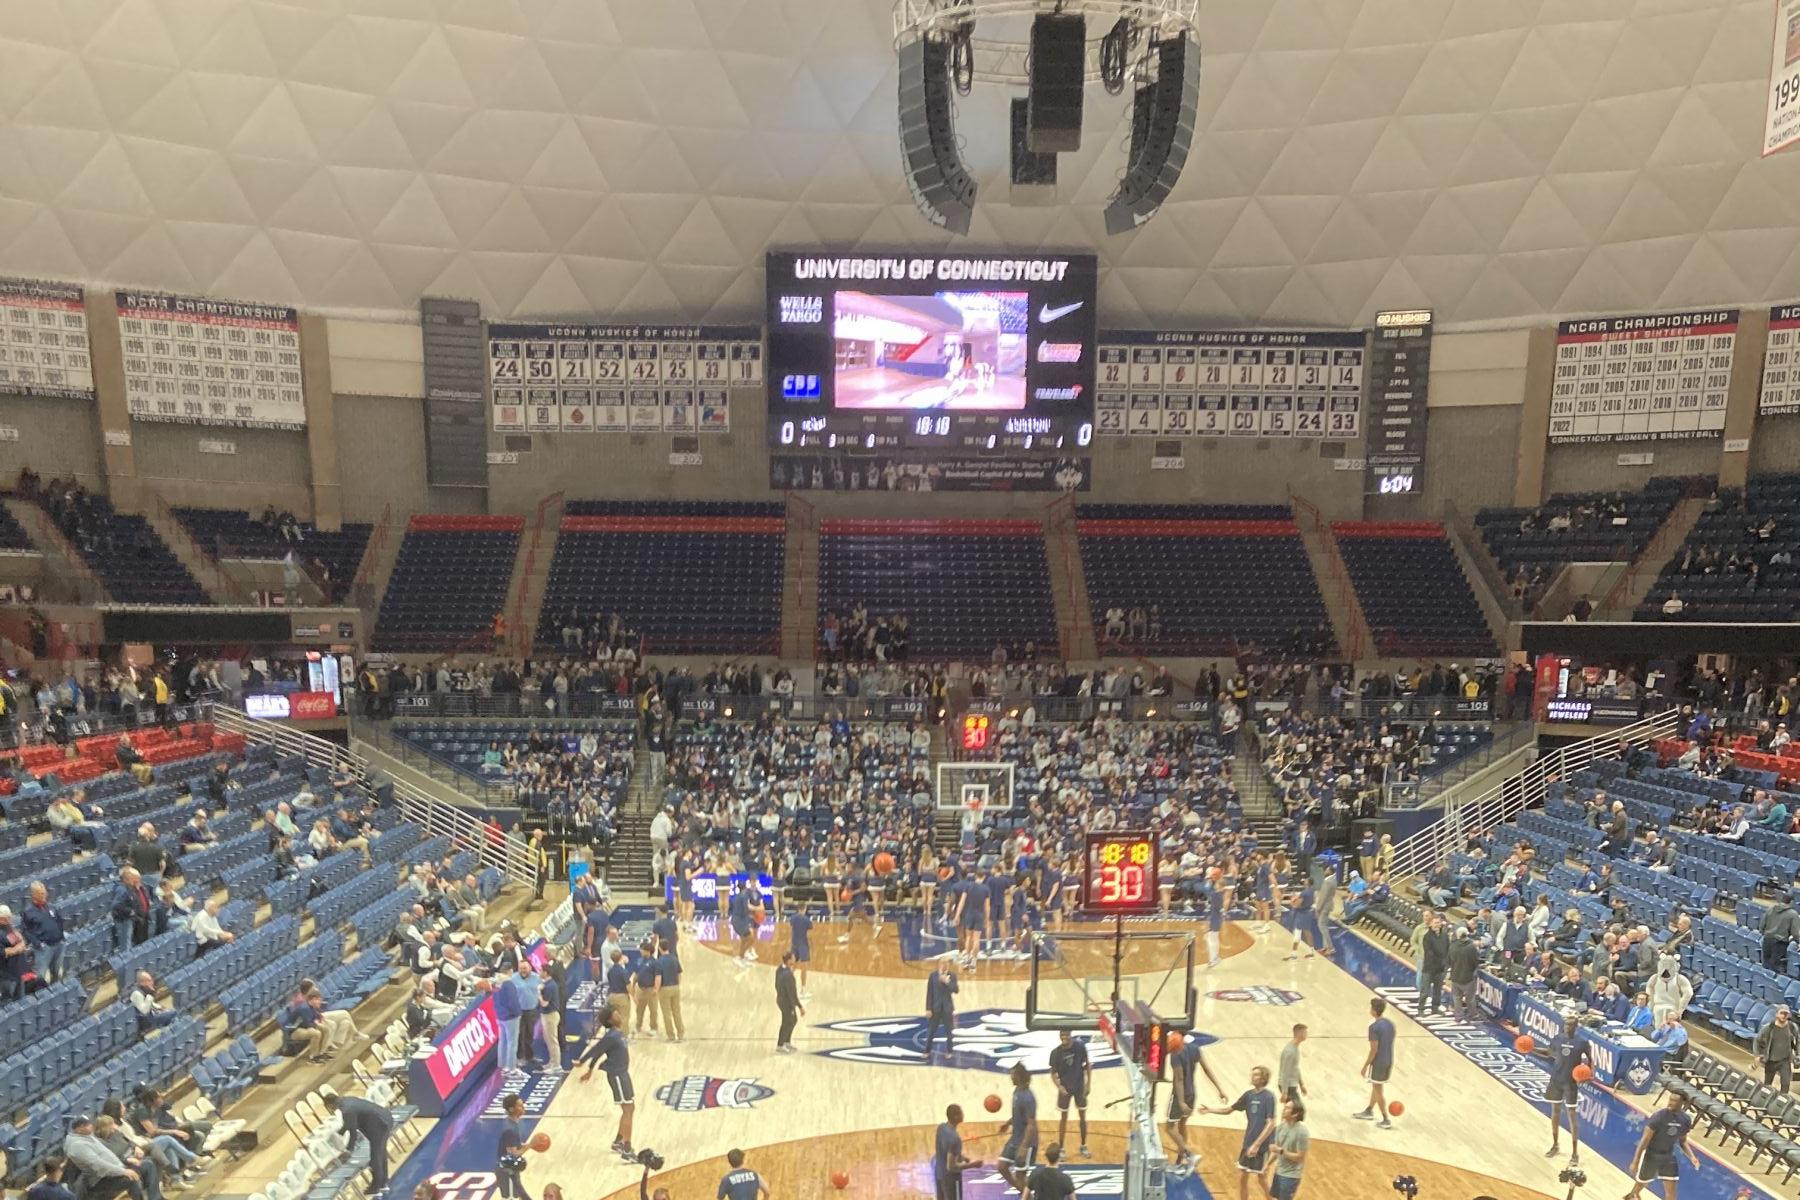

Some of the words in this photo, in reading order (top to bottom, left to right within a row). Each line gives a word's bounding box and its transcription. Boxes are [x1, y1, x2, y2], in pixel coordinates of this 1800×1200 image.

[795, 259, 906, 279] UNIVERSITY
[909, 260, 934, 280] OF
[937, 260, 1068, 281] CONNECTICUT
[126, 296, 168, 309] NCAA
[176, 301, 288, 319] CHAMPIONSHIP
[1392, 313, 1430, 323] HUSKIES
[1568, 321, 1607, 333] NCAA
[1614, 312, 1728, 330] CHAMPIONSHIP
[548, 328, 586, 336] UCONN
[591, 328, 640, 337] HUSKIES
[1156, 334, 1194, 342] UCONN
[1200, 334, 1246, 342] HUSKIES
[1252, 334, 1264, 342] OF
[1270, 335, 1306, 343] HONOR
[1601, 330, 1638, 340] SWEET
[1561, 347, 1577, 358] 1991
[1584, 346, 1602, 357] 1994
[1609, 344, 1628, 356] 1995
[1661, 341, 1679, 352] 1997
[1687, 339, 1704, 350] 1998
[1713, 336, 1732, 348] 1999
[496, 360, 518, 377] 24
[530, 361, 552, 378] 50
[566, 361, 584, 378] 21
[600, 362, 620, 378] 52
[633, 362, 656, 378] 42
[670, 362, 686, 378] 25
[706, 362, 718, 378] 33
[740, 362, 752, 378] 10
[1106, 366, 1119, 382] 32
[1143, 366, 1150, 382] 3
[1207, 366, 1220, 382] 20
[1240, 366, 1252, 383] 31
[1272, 367, 1286, 383] 23
[1305, 367, 1320, 384] 31
[1340, 368, 1353, 384] 14
[1558, 366, 1576, 377] 2000
[1582, 364, 1600, 375] 2001
[1607, 362, 1626, 374] 2002
[1632, 361, 1652, 372] 2003
[1658, 360, 1677, 371] 2004
[1683, 358, 1703, 370] 2005
[1710, 356, 1730, 368] 2006
[1556, 384, 1574, 395] 2007
[1605, 381, 1624, 392] 2009
[1630, 380, 1649, 391] 2010
[1656, 378, 1675, 390] 2011
[1682, 377, 1700, 388] 2012
[1708, 375, 1727, 388] 2013
[1554, 402, 1572, 414] 2014
[1578, 401, 1596, 412] 2015
[1603, 400, 1622, 411] 2016
[1628, 398, 1646, 410] 2017
[1654, 397, 1672, 408] 2018
[1679, 396, 1698, 408] 2019
[1706, 394, 1724, 406] 2021
[1100, 411, 1120, 427] 23
[1140, 411, 1148, 427] 4
[1168, 412, 1187, 428] 30
[1206, 412, 1215, 428] 3
[1270, 412, 1284, 428] 15
[1299, 414, 1321, 430] 24
[1332, 414, 1354, 430] 33
[1552, 421, 1570, 432] 2022
[780, 421, 794, 444] 0
[1078, 423, 1092, 446] 0
[1552, 435, 1612, 444] CONNECTICUT
[1616, 433, 1657, 441] WOMEN'S
[1660, 431, 1720, 440] BASKETBALL
[412, 698, 428, 706] 101
[618, 699, 634, 708] 101
[696, 701, 715, 710] 102
[904, 703, 922, 712] 102
[1470, 702, 1488, 710] 105
[1548, 702, 1592, 712] MICHAELS
[1550, 711, 1588, 720] JEWELERS
[964, 729, 986, 748] 30
[1102, 866, 1143, 902] 30
[443, 1017, 486, 1078] DATTCO
